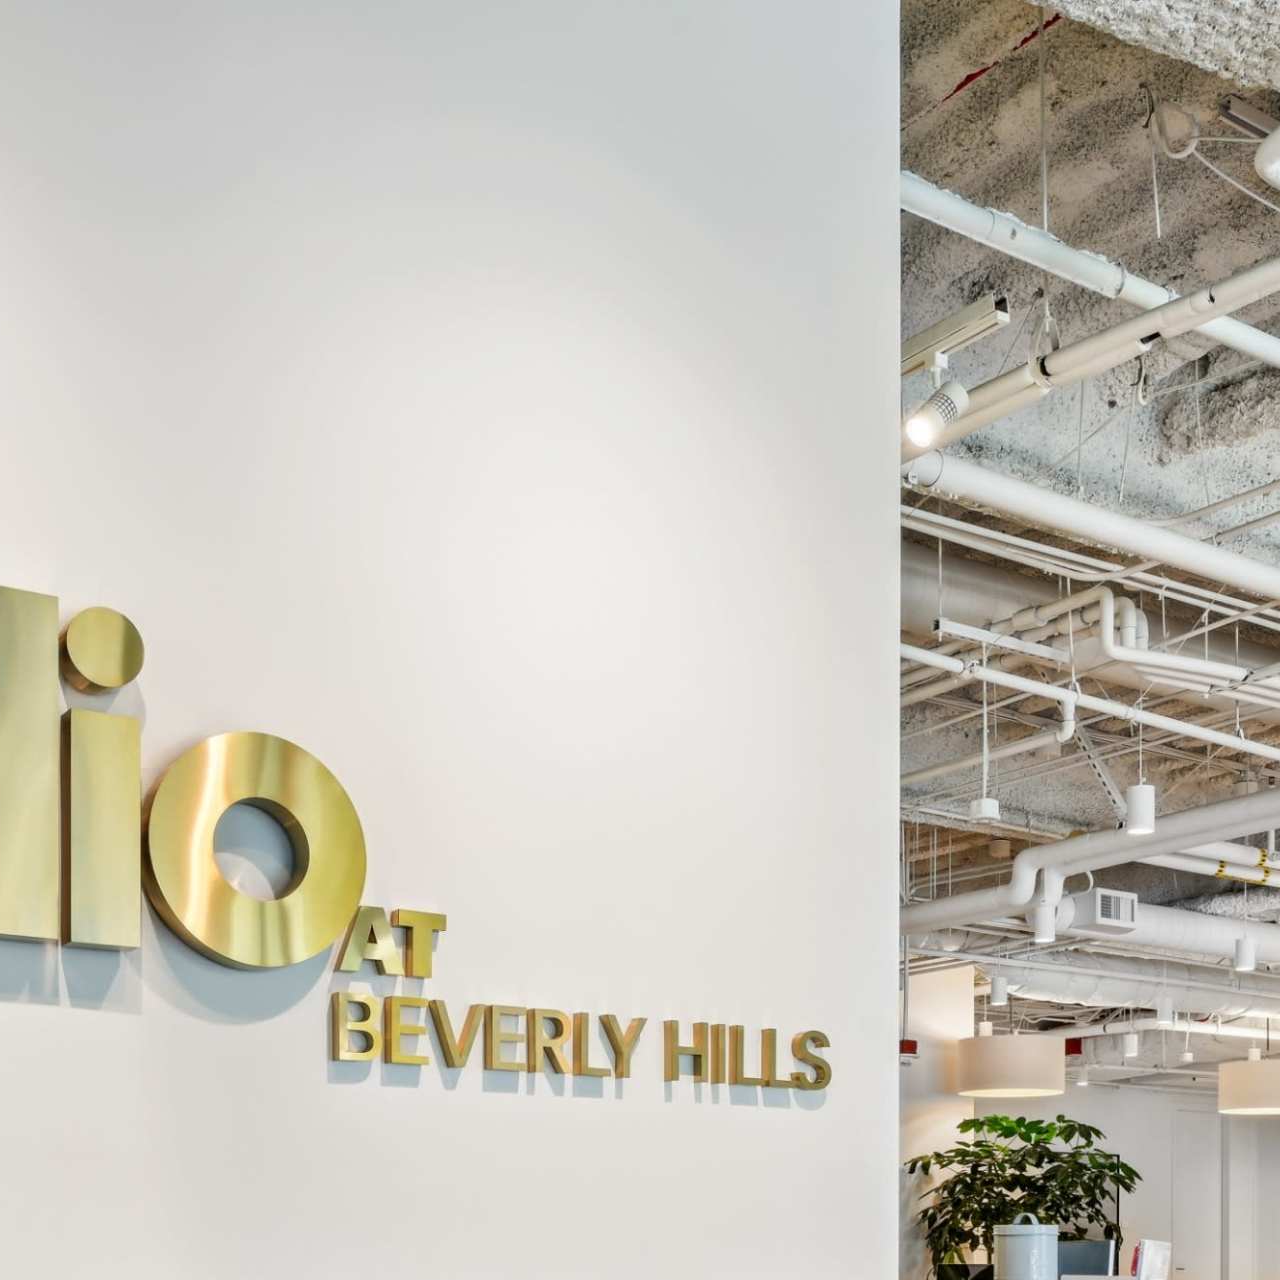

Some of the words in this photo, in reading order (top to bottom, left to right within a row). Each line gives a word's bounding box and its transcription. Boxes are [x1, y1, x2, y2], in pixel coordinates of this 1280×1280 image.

[333, 905, 447, 978] AT
[331, 992, 648, 1078] BEVERLY
[663, 1019, 833, 1091] HILLS
